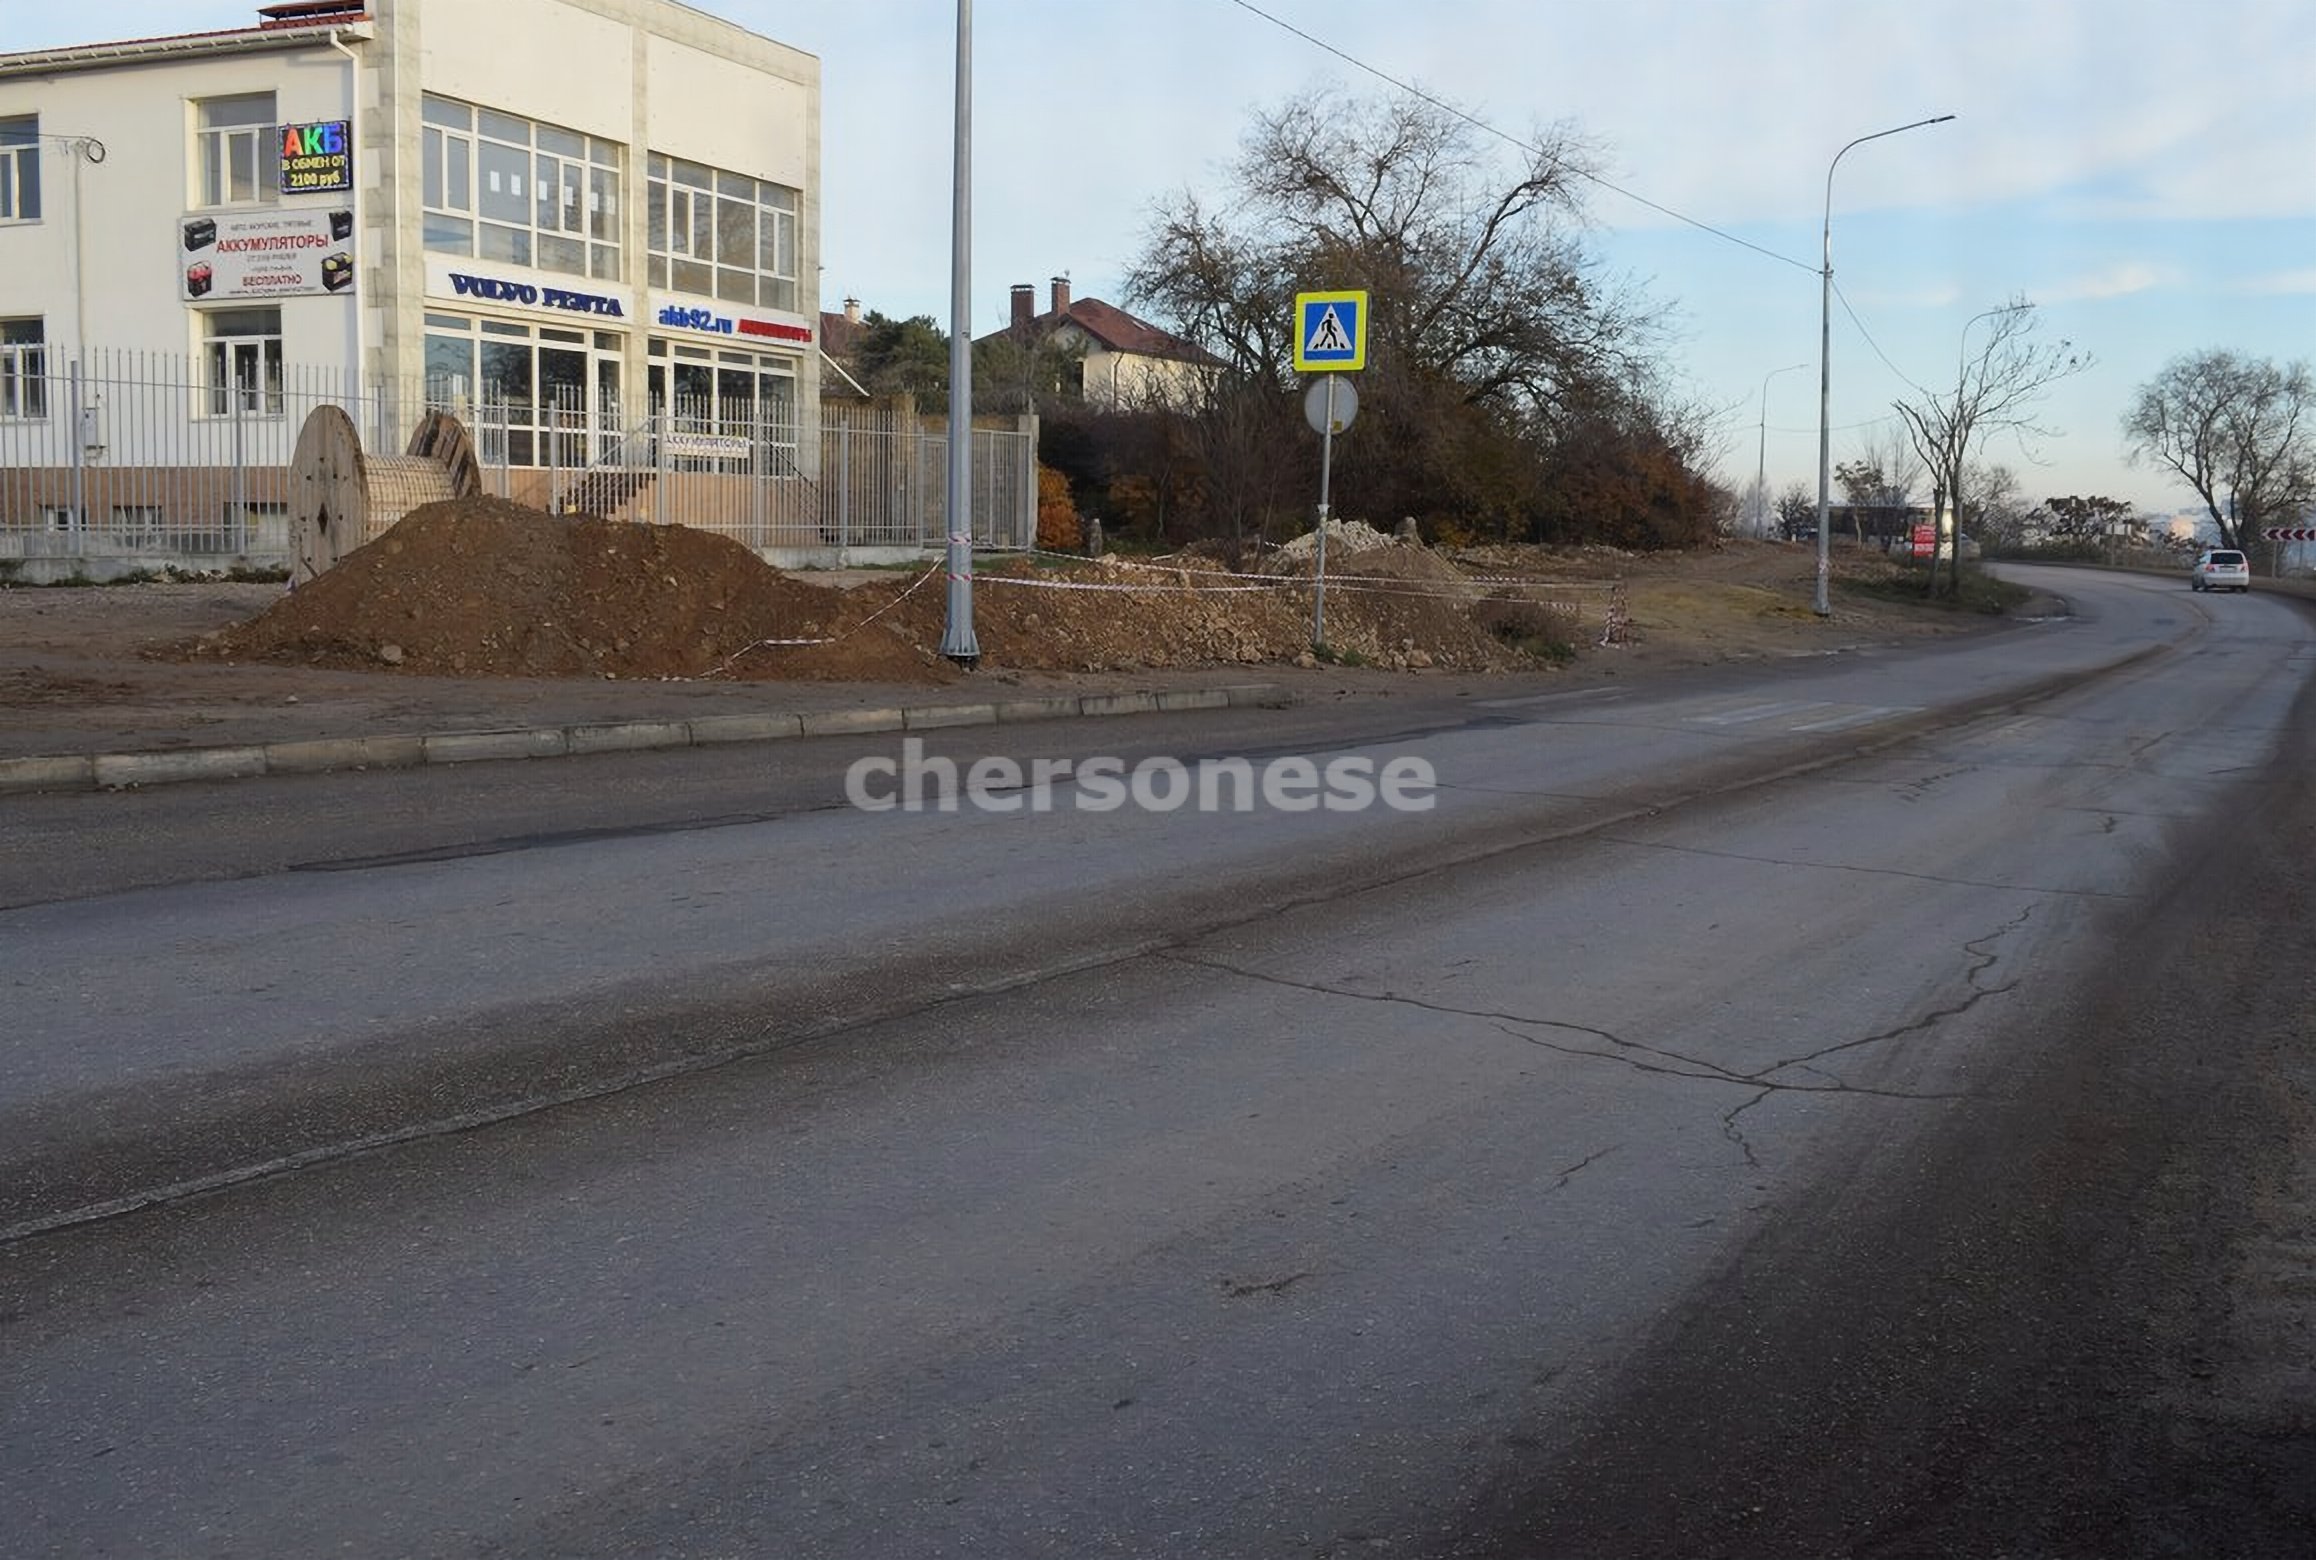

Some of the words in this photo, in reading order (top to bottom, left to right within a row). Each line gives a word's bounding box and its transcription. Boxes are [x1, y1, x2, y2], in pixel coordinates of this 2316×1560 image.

[284, 123, 343, 156] АКБ
[217, 234, 329, 253] АККУМУЛЯТОРЫ
[242, 273, 303, 287] БЕСПЛАТНО
[448, 273, 538, 305] VOLVO
[541, 287, 625, 317] PENTA
[659, 305, 732, 334] akb92.ru
